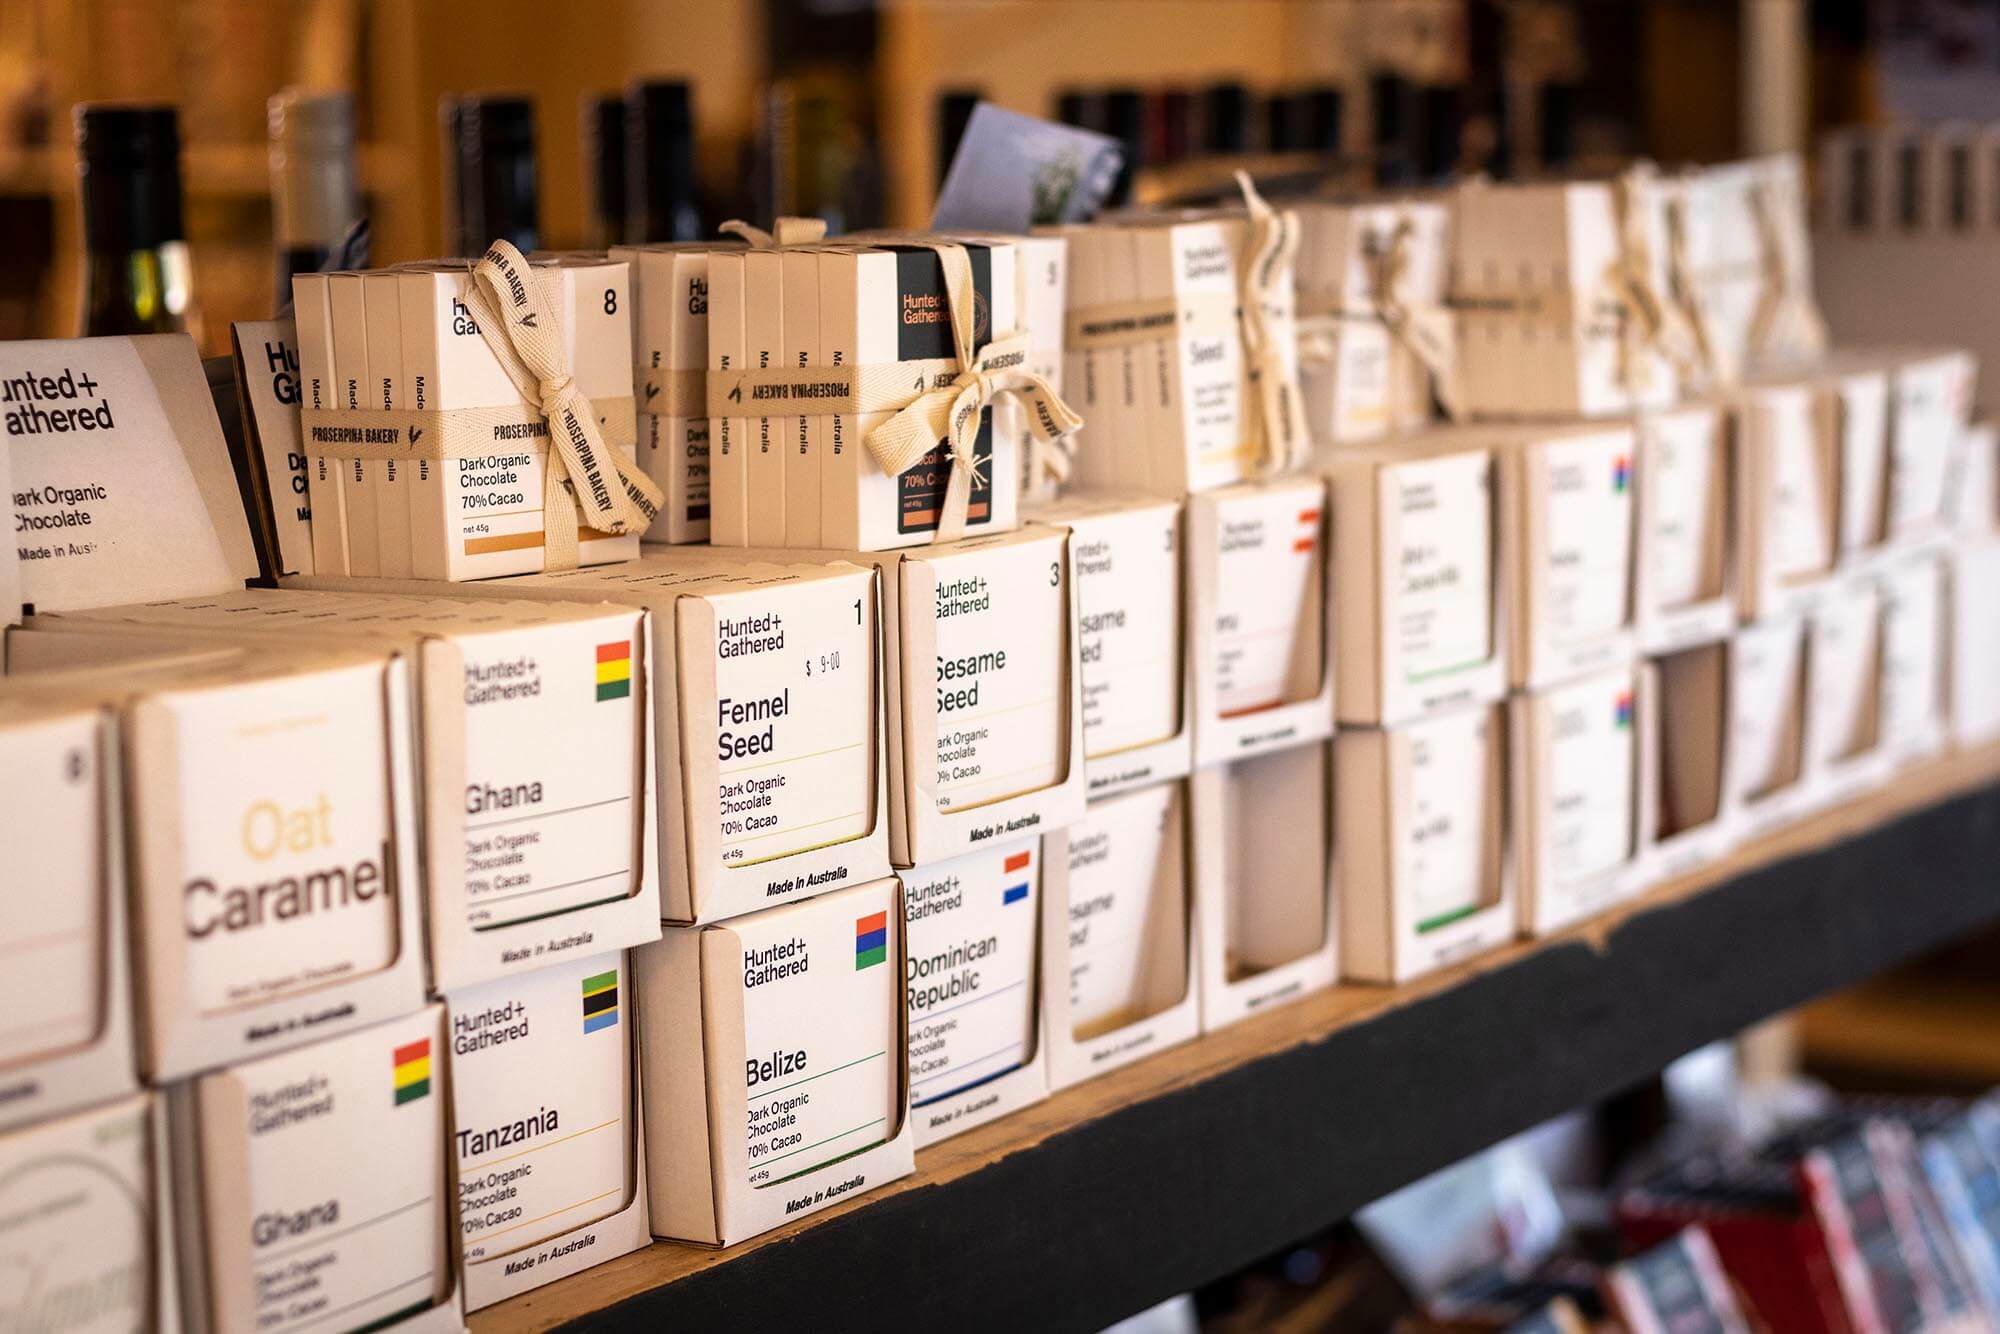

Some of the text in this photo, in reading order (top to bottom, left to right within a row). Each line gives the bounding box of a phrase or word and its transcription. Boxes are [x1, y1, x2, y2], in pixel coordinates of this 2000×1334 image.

[505, 267, 527, 307] BAKERY
[604, 288, 617, 315] 8
[2, 368, 98, 401] unted+
[416, 376, 425, 410] Made
[752, 382, 849, 399] PROSERPINA BAKERY
[6, 399, 115, 435] athered
[312, 427, 399, 444] PROSERPINA BAKERY
[494, 420, 549, 441] PROSERPINA
[761, 416, 770, 454] stralia
[459, 452, 531, 472] Dark Organic
[460, 471, 517, 489] Chocolate
[588, 470, 613, 512] BAKERY
[13, 483, 107, 507] ark Organic
[462, 491, 524, 510] 70% Cacao
[463, 523, 489, 534] net 45g
[18, 546, 51, 561] Made
[54, 545, 65, 557] in
[1077, 540, 1110, 558] nted+
[1050, 562, 1060, 587] 3
[1077, 558, 1112, 576] thered
[854, 599, 861, 625] 1
[1080, 610, 1125, 634] same
[719, 613, 782, 639] Hunted+
[718, 630, 784, 659] Gathered
[1080, 640, 1101, 663] ed
[465, 657, 537, 683] Hunted+
[464, 677, 541, 706] Gathered
[719, 687, 789, 727] Fennel
[718, 724, 774, 761] Seed
[937, 727, 989, 749] ark Organic
[937, 745, 977, 764] hocolate
[952, 763, 982, 781] Cacao
[466, 781, 543, 815] Ghana
[719, 774, 786, 799] Dark Organic
[720, 794, 772, 815] Chocolate
[241, 793, 334, 862] Oat
[745, 814, 778, 831] Cacao
[969, 813, 1041, 842] Made in Australia
[183, 839, 394, 941] Caramel
[766, 866, 848, 897] Made in Australia
[906, 876, 960, 905] Hunted+
[905, 890, 961, 922] Gathered
[744, 938, 806, 970] Hunted+
[907, 936, 998, 982] Dominican
[743, 955, 809, 989] Gathered
[454, 1001, 525, 1035] Hunted+
[454, 1018, 529, 1056] Gathered
[909, 1019, 957, 1044] ark Organic
[746, 1049, 807, 1087] Belize
[920, 1056, 949, 1073] Cacao
[771, 1092, 809, 1113] Organic
[456, 1106, 559, 1159] Tanzania
[771, 1132, 802, 1151] Cacao
[487, 1163, 532, 1186] Organic
[785, 1174, 865, 1215] Made in Australia
[252, 1199, 341, 1248] Ghana
[486, 1205, 522, 1227] Cacao
[504, 1234, 596, 1277] Made in Australia
